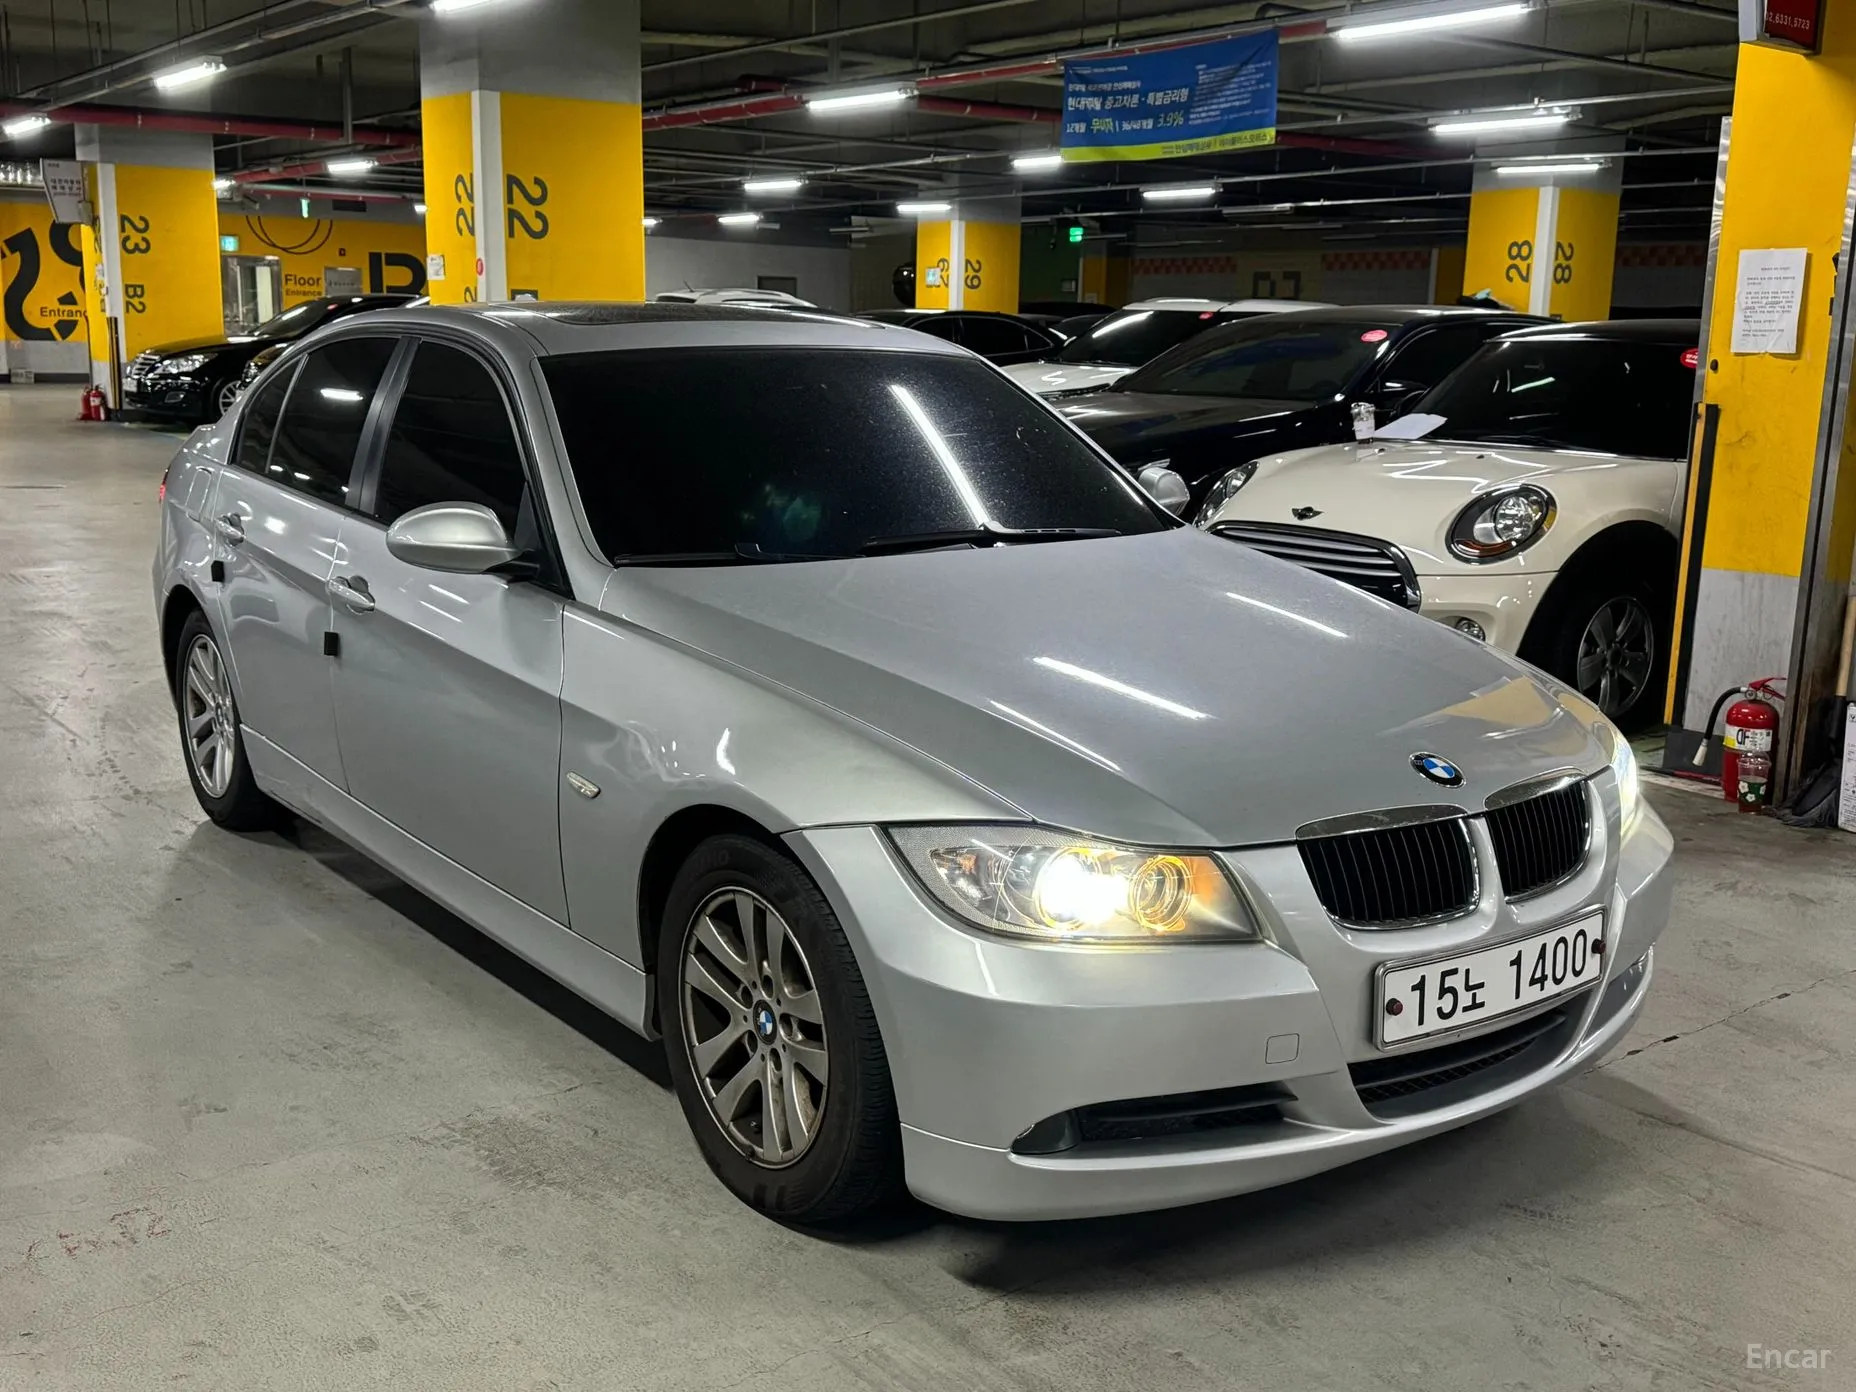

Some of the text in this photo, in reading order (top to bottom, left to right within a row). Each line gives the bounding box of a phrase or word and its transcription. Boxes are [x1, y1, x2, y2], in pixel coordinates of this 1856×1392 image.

[1156, 110, 1185, 128] 3.9%
[506, 173, 549, 240] 22
[119, 214, 151, 255] 23
[964, 258, 983, 290] 29
[1505, 239, 1533, 283] 28
[1553, 241, 1575, 284] 28
[284, 274, 322, 286] Floor
[285, 288, 323, 297] Entrance
[124, 283, 147, 314] B2
[1410, 928, 1588, 1027] 15노 1400
